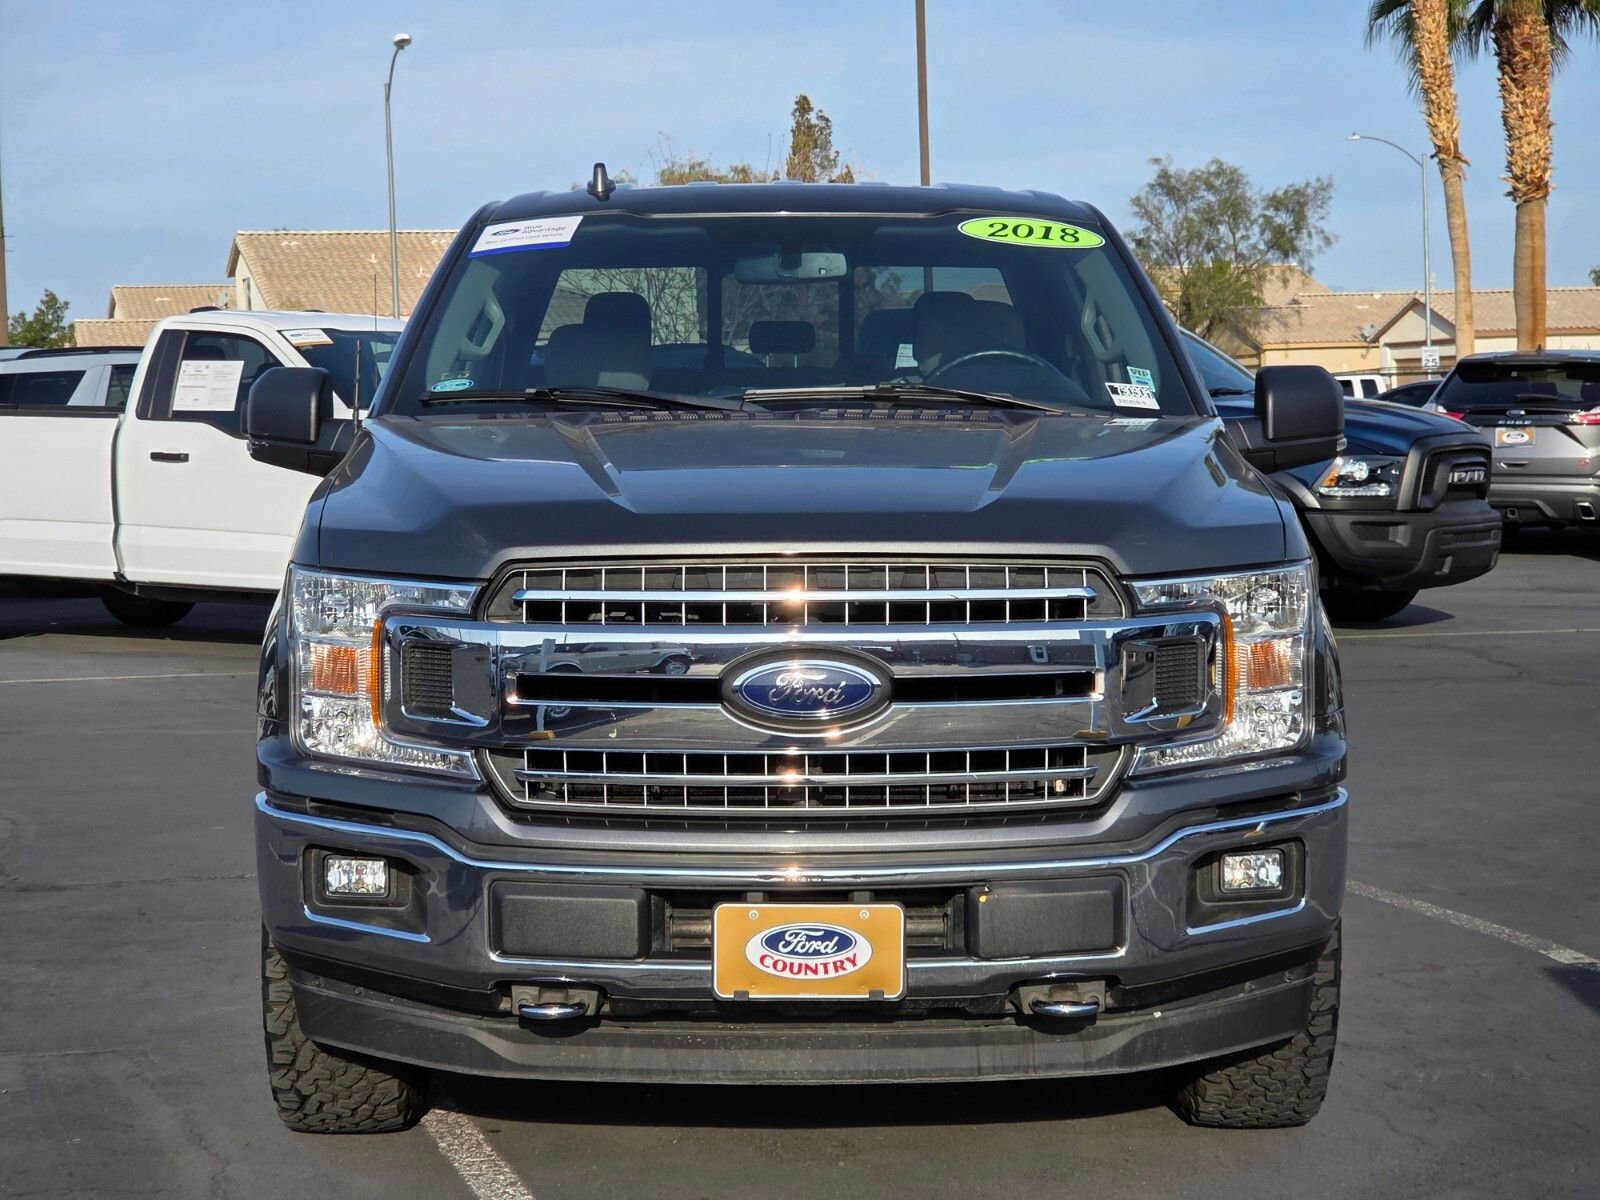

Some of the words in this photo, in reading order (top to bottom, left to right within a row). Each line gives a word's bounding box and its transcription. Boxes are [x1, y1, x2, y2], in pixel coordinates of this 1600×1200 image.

[987, 222, 1080, 244] 2018
[1129, 368, 1149, 377] VIP
[1424, 358, 1438, 368] 25
[768, 671, 847, 705] Ford
[778, 929, 840, 954] Ford
[759, 953, 858, 976] COUNTRY
